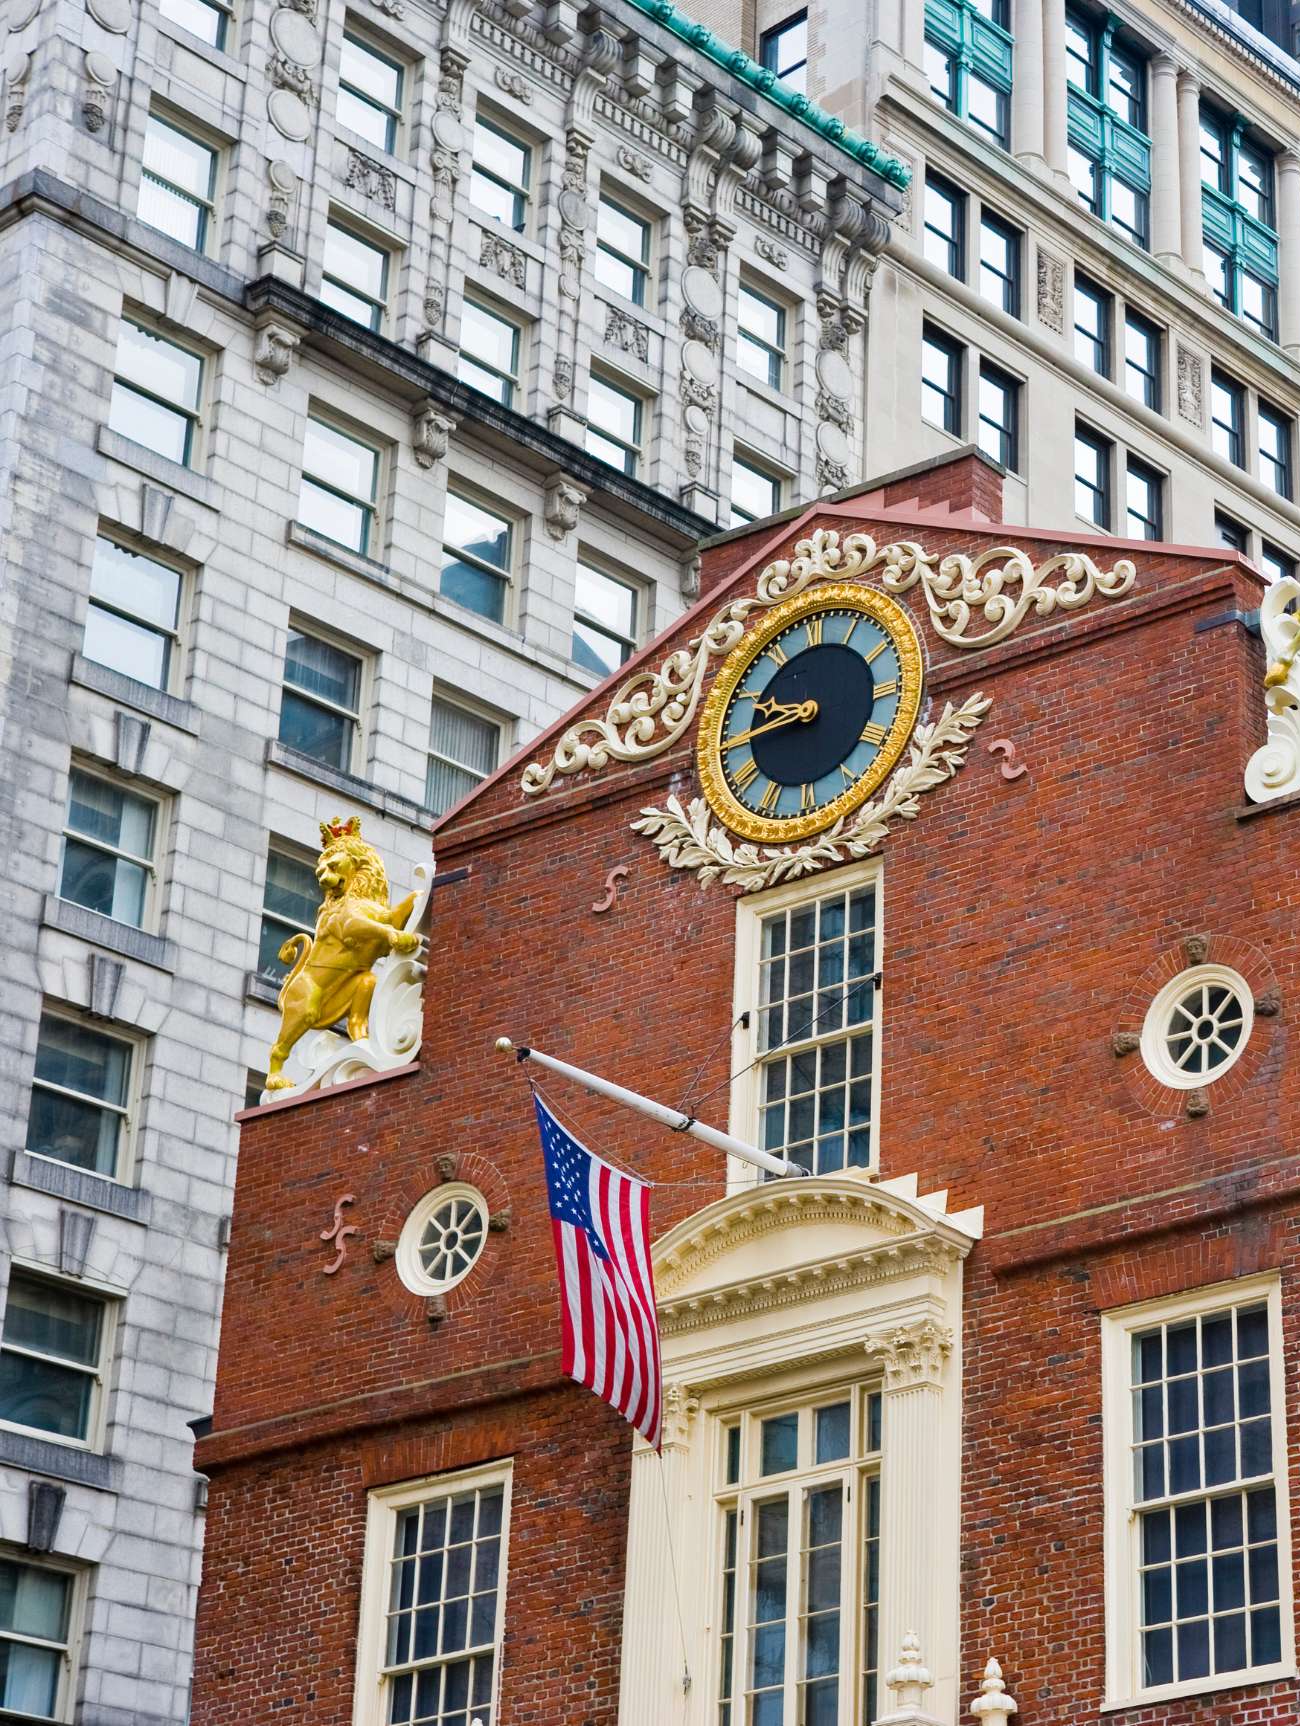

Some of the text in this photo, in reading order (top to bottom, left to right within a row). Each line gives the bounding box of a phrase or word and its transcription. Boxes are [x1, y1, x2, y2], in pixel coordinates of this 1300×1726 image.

[806, 619, 823, 648] XII
[766, 644, 789, 670] XI
[865, 639, 889, 665] II
[874, 679, 897, 700] III
[859, 720, 887, 746] IIII
[840, 763, 858, 787] V
[760, 780, 783, 811] VII
[801, 783, 816, 810] VI
